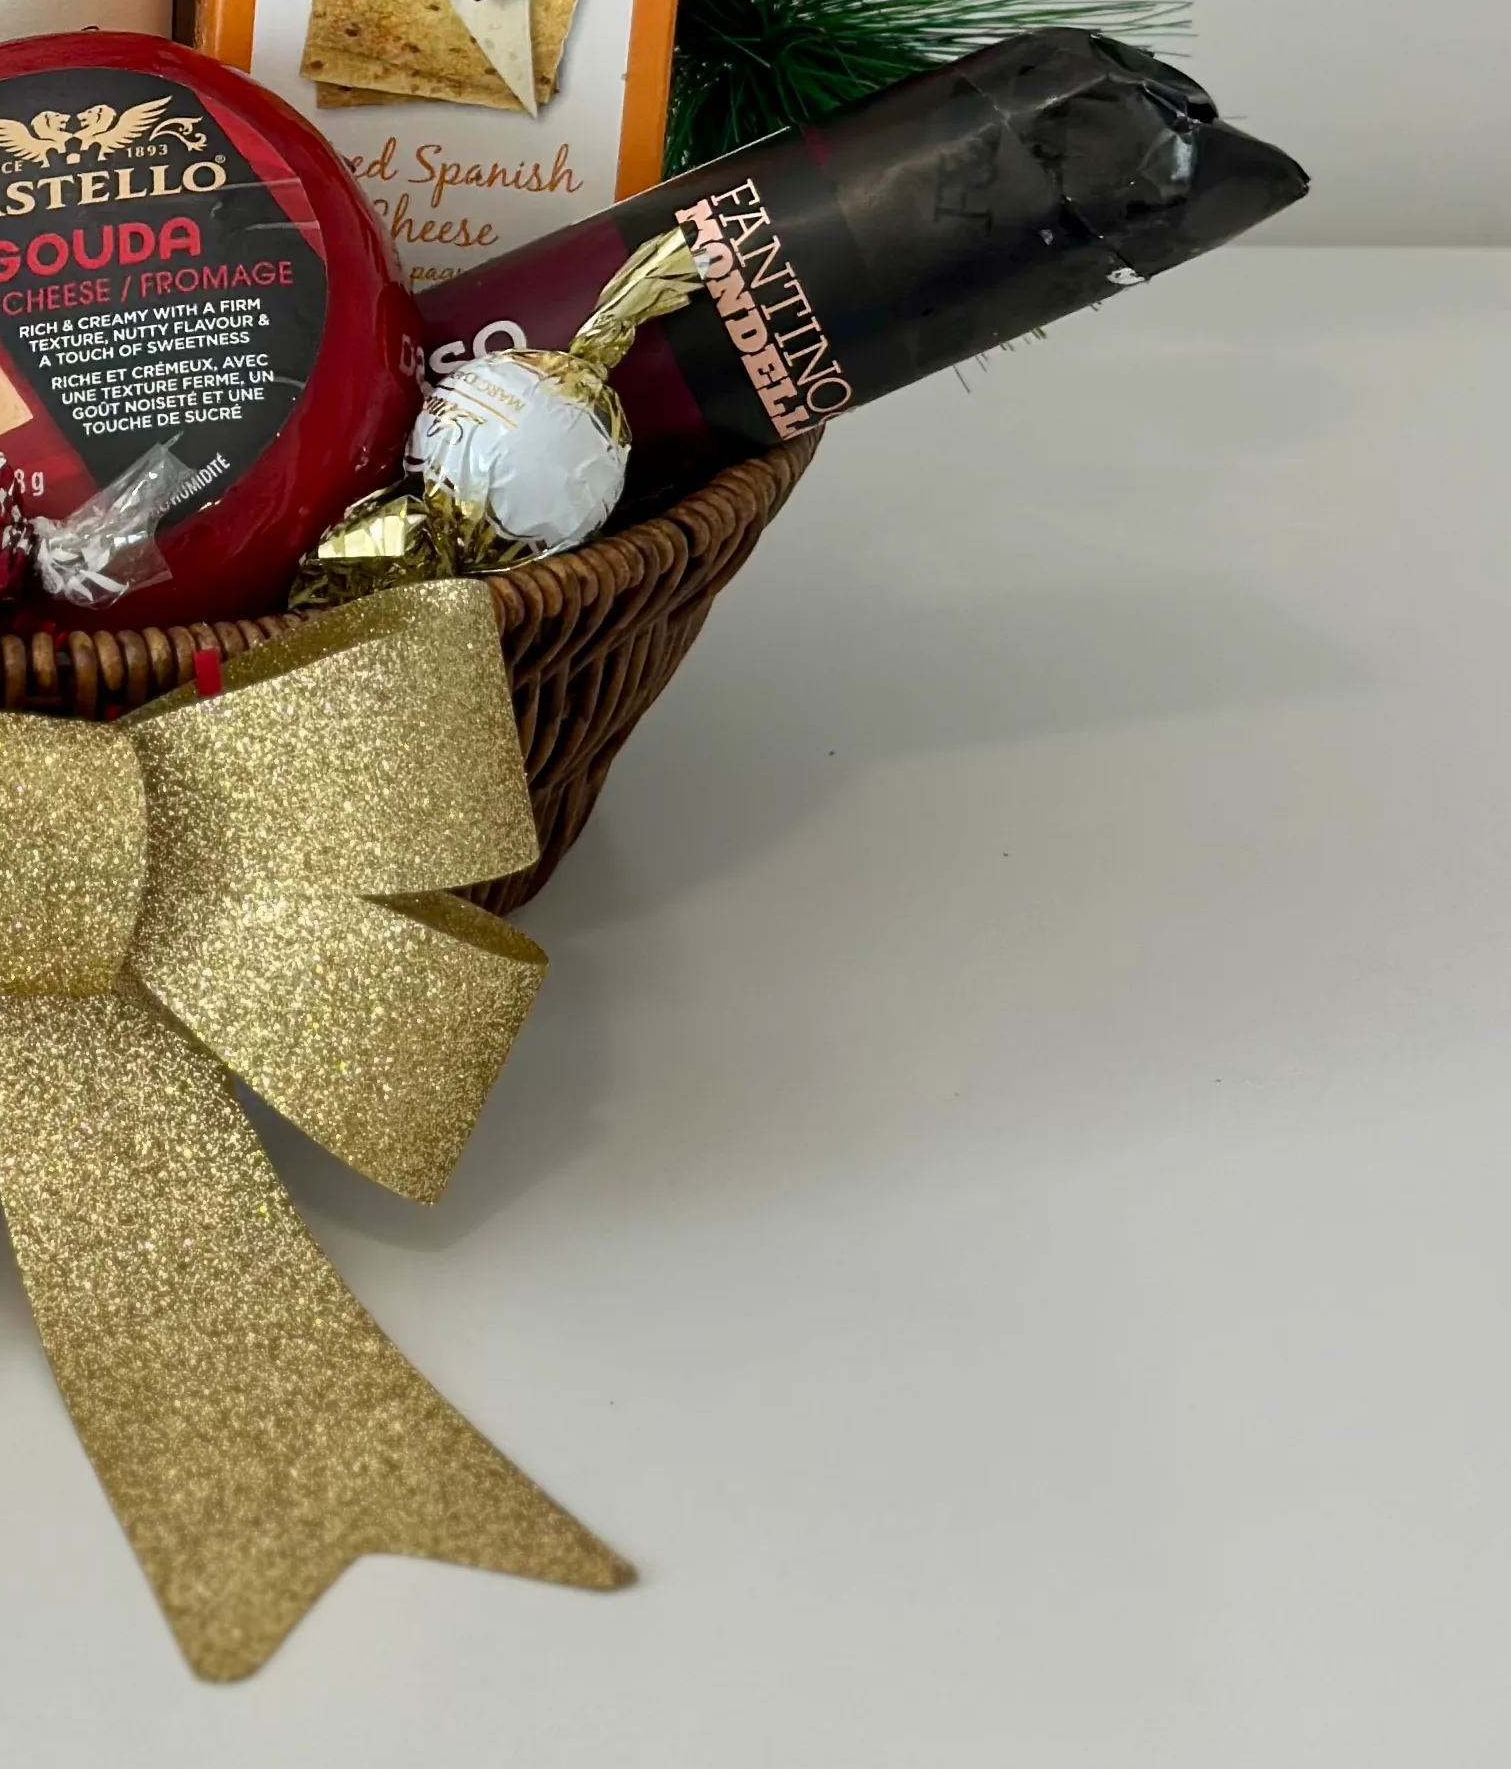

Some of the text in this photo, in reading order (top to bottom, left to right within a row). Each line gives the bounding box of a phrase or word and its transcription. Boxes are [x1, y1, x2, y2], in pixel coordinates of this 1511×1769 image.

[125, 144, 169, 159] 1893
[407, 143, 584, 209] Spanish
[1, 277, 110, 317] CHEESE
[141, 261, 294, 298] FROMAGE
[710, 178, 853, 414] FANTINO
[19, 298, 261, 339] RICH & CREAMY WITH A FIRM
[29, 313, 270, 353] TEXTURE, NUTTY FLAVOUR &
[38, 331, 250, 368] A TOUCH OF SWEETNESS
[51, 370, 101, 390] RICHE
[106, 367, 128, 382] ET
[222, 353, 269, 369] AVEC
[61, 369, 275, 405] UNE TEXTURE FERME, UN
[72, 399, 120, 421] GOÛT
[203, 390, 223, 404] ET
[228, 387, 265, 403] UNE
[82, 403, 242, 436] TOUCHE DE SUCRÉ
